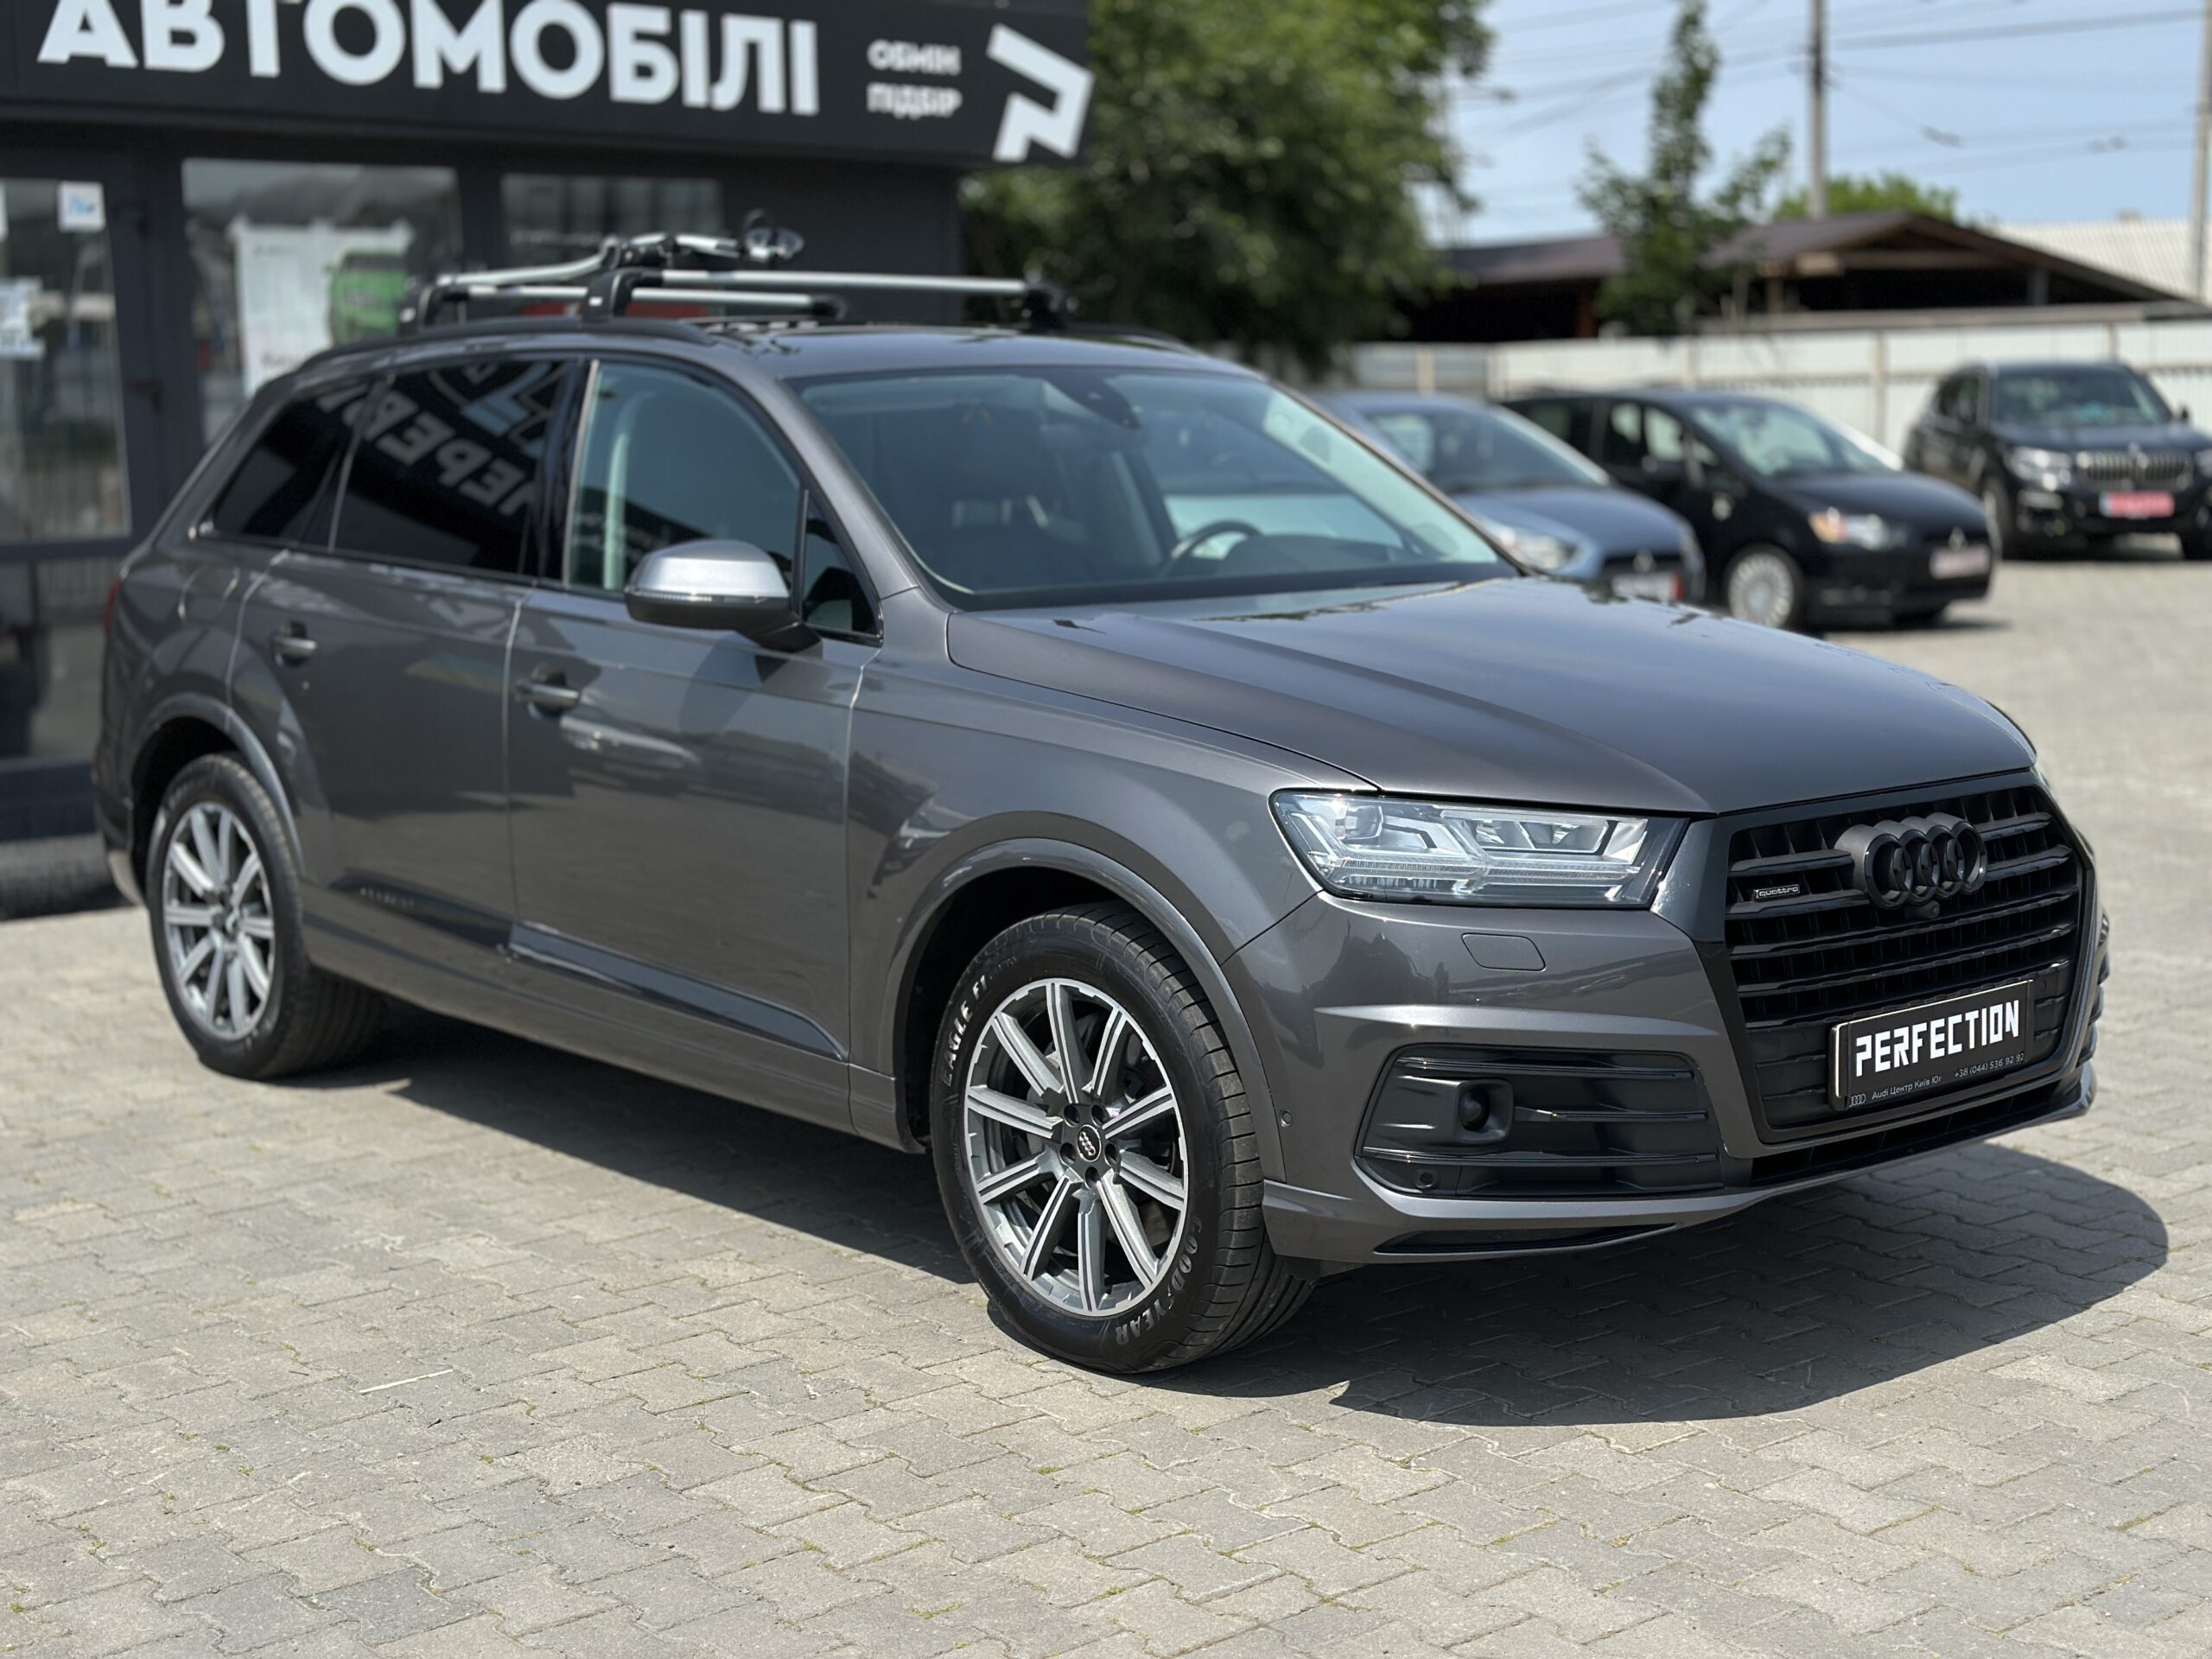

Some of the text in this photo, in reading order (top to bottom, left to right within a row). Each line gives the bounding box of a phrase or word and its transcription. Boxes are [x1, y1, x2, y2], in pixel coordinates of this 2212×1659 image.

[36, 0, 820, 117] АВТОМОБІЛІ
[867, 39, 961, 77] ОБМІН
[867, 81, 963, 121] ПІДБІР
[1758, 886, 1799, 898] quattro
[940, 1000, 974, 1087] EAGLE
[1856, 1000, 2019, 1077] PERFECTION
[1955, 1052, 2024, 1077] +38 (044) 536 92 92
[1872, 1088, 1889, 1100] Audi
[1890, 1083, 1914, 1095] Центр
[1914, 1078, 1930, 1089] Київ
